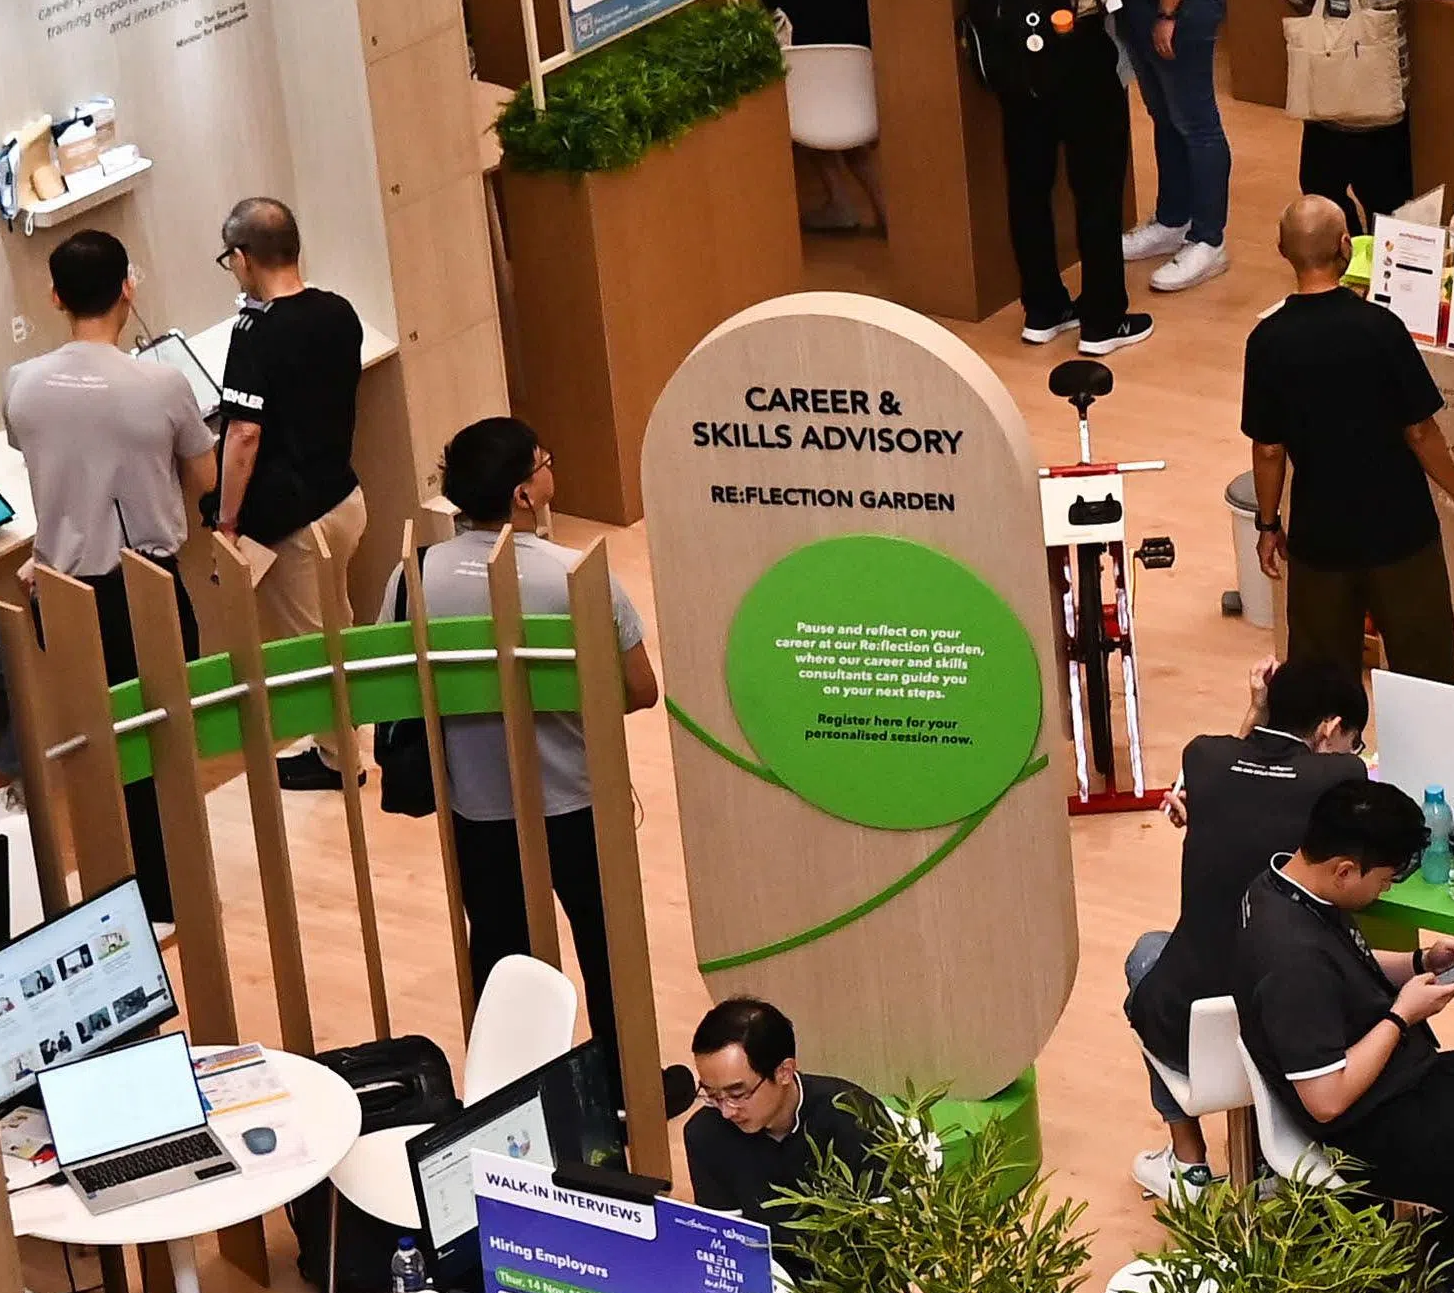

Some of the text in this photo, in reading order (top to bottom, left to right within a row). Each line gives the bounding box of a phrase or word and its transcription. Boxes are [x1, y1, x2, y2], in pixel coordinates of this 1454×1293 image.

[744, 386, 902, 416] CAREER &
[692, 422, 964, 455] SKILLS ADVISORY
[710, 484, 955, 511] RE:FLECTION GARDEN
[797, 622, 961, 642] Pause and reflect on your
[775, 638, 985, 657] career at our Re:flection Garden,
[795, 653, 968, 670] where our career and skills
[823, 686, 946, 701] on your next steps.
[485, 1172, 642, 1223] WALK-IN INTERVIEWS
[489, 1235, 609, 1279] Hiring Employers
[499, 1271, 524, 1289] Thur,
[527, 1278, 541, 1292] 14
